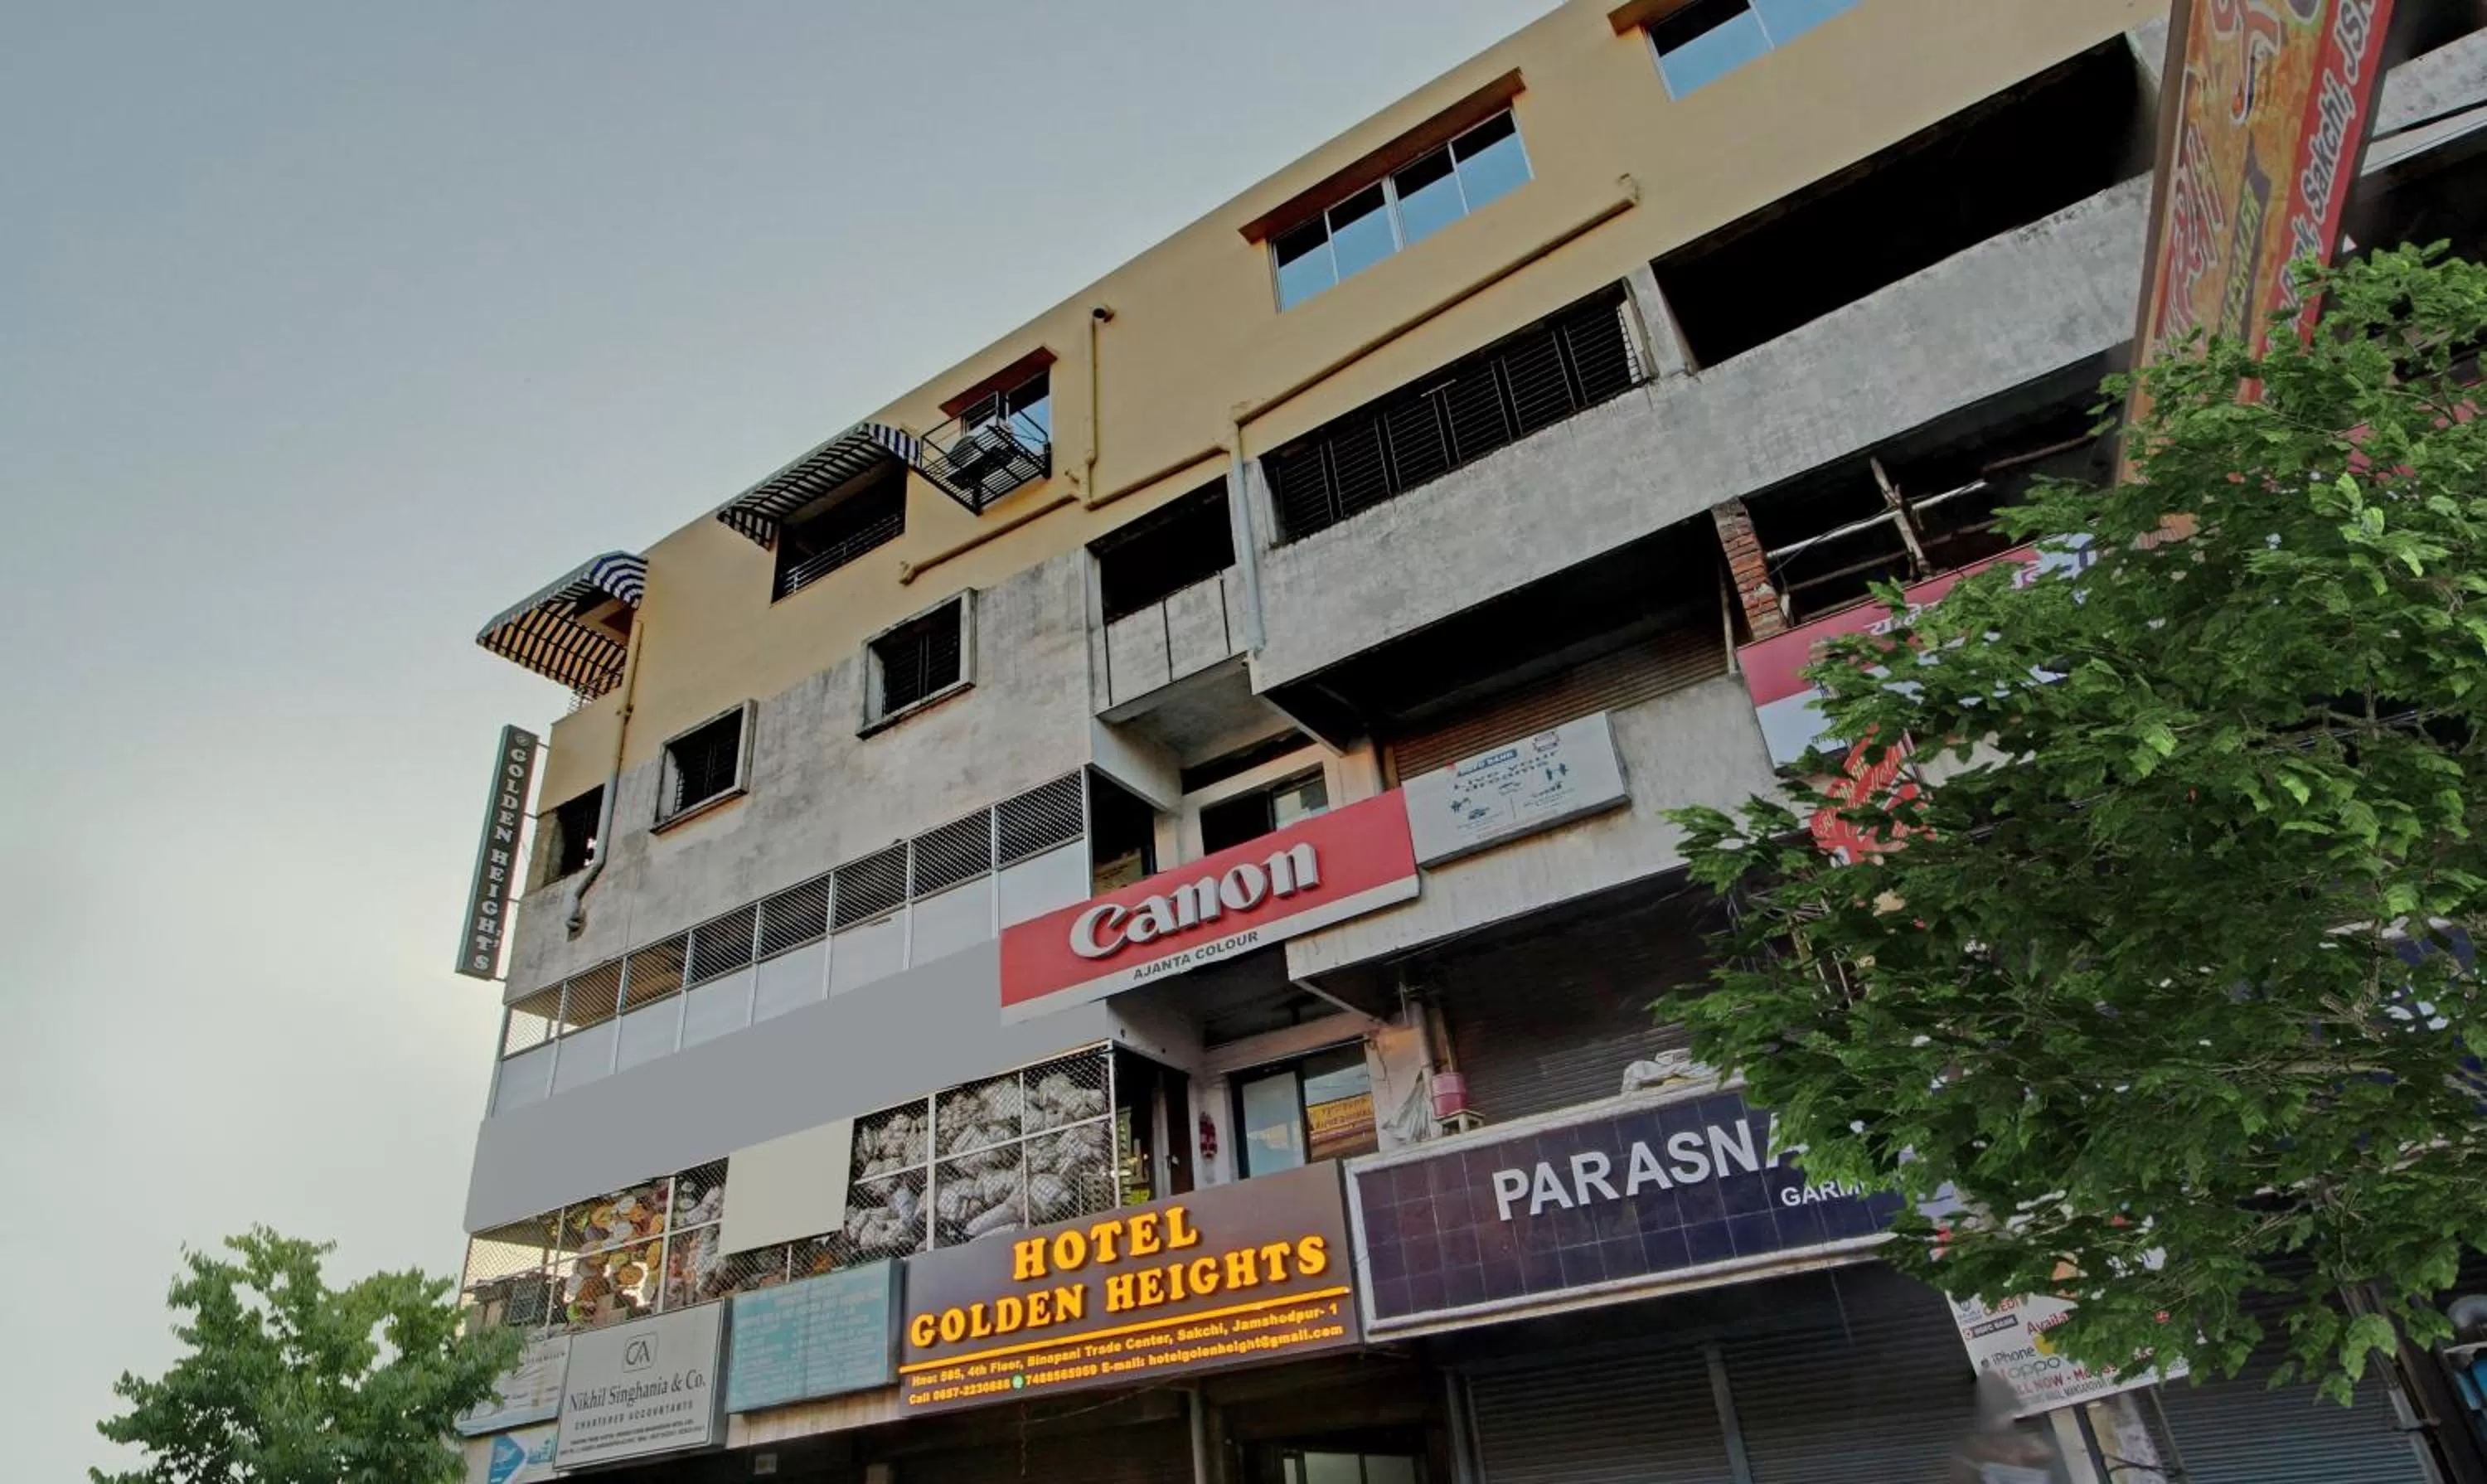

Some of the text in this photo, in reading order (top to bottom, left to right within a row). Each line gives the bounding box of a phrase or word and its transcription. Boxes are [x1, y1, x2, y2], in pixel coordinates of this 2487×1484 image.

[473, 749, 527, 972] GOLDEN HEIGHTS
[1069, 841, 1321, 958] Canon
[1132, 931, 1258, 981] AJANTA COLOUR
[1012, 1206, 1199, 1281] HOTEL
[910, 1283, 1085, 1348] GOLDEN
[1105, 1235, 1328, 1312] HEIGHTS
[967, 1365, 987, 1378] 4th
[990, 1360, 1024, 1374] Floor,
[1084, 1341, 1122, 1358] Trade
[1125, 1332, 1174, 1350] Center,
[1176, 1322, 1229, 1341] Sakchi,
[1991, 1346, 2036, 1366] iPhone
[569, 1387, 607, 1411] Nikhil
[608, 1376, 667, 1408] Singhania
[671, 1372, 682, 1393] &
[686, 1369, 706, 1390] Co.
[574, 1399, 694, 1431] CHARTERED ACCOUNTANTS
[909, 1392, 930, 1405] Call
